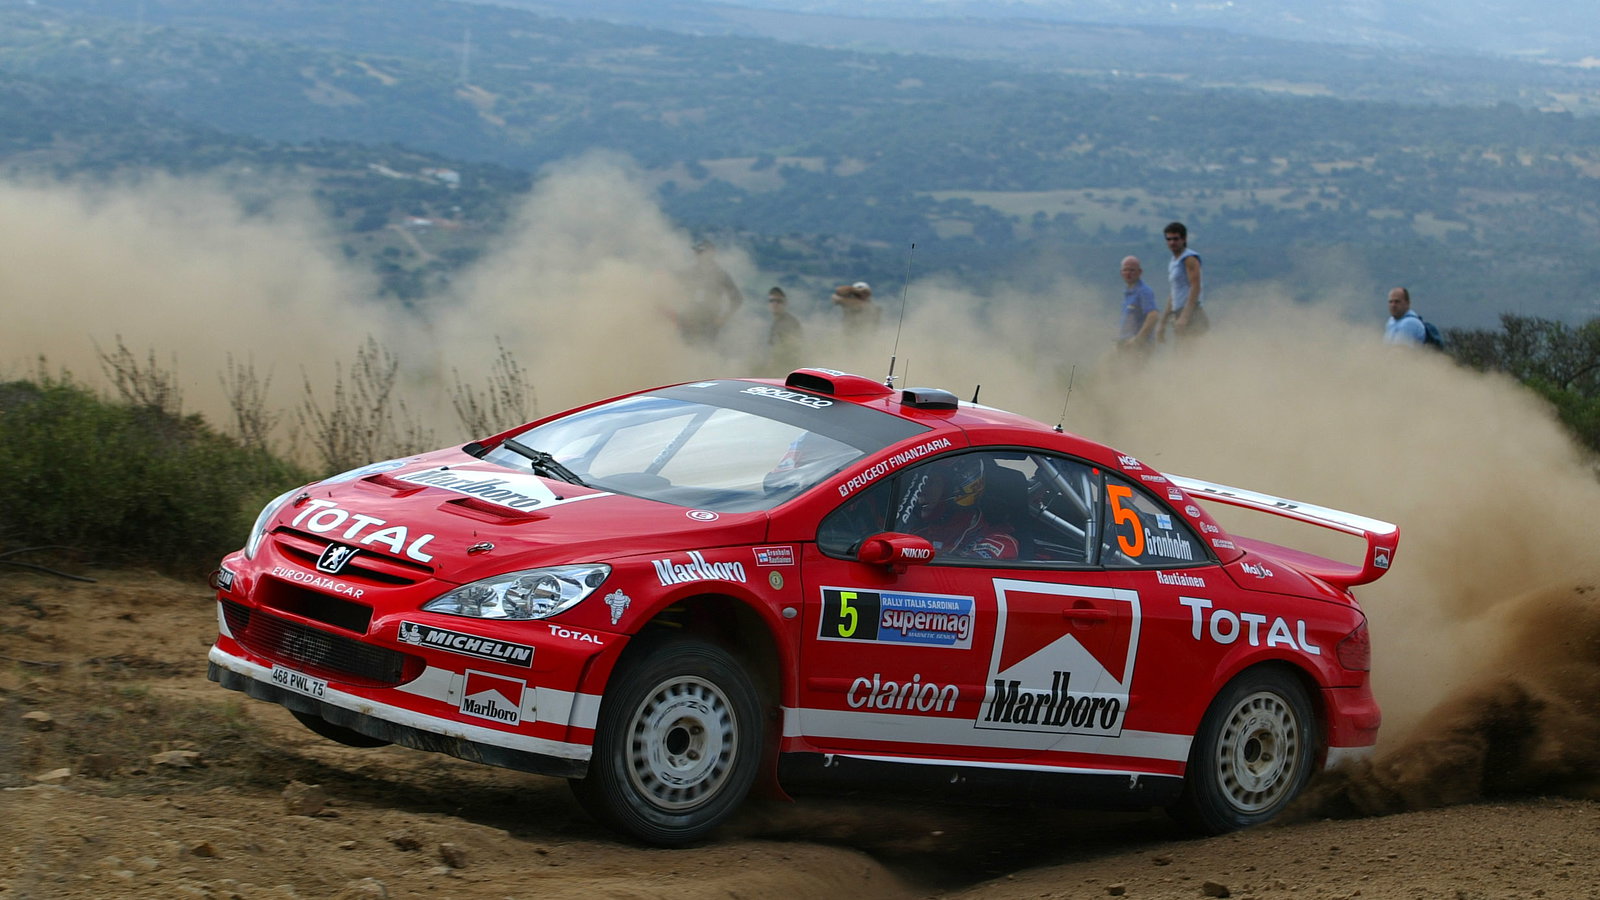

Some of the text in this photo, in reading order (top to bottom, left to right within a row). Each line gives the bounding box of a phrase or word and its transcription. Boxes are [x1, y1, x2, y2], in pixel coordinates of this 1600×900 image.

[745, 386, 833, 408] sparco
[847, 438, 951, 492] PEUGEOT FINANZIARIA
[1118, 455, 1140, 466] NGK
[400, 470, 541, 508] Marlboro
[291, 499, 435, 563] TOTAL
[1106, 485, 1145, 557] 5
[901, 547, 930, 559] NIKKO
[1144, 528, 1193, 561] Gronholm
[272, 566, 364, 599] EURODATACAR
[651, 551, 747, 587] Marlboro
[1156, 571, 1206, 588] Rautiainen
[838, 592, 858, 638] 5
[882, 597, 960, 610] RALLY ITALIA SARDINIA
[548, 624, 604, 645] TOTAL
[881, 609, 970, 640] supermag
[1179, 597, 1320, 655] TOTAL
[425, 630, 530, 661] MICHELIN
[272, 669, 325, 696] 468 PWL 75
[847, 673, 960, 712] Clarion
[462, 698, 517, 723] Marlboro
[984, 670, 1121, 730] Marlboro
